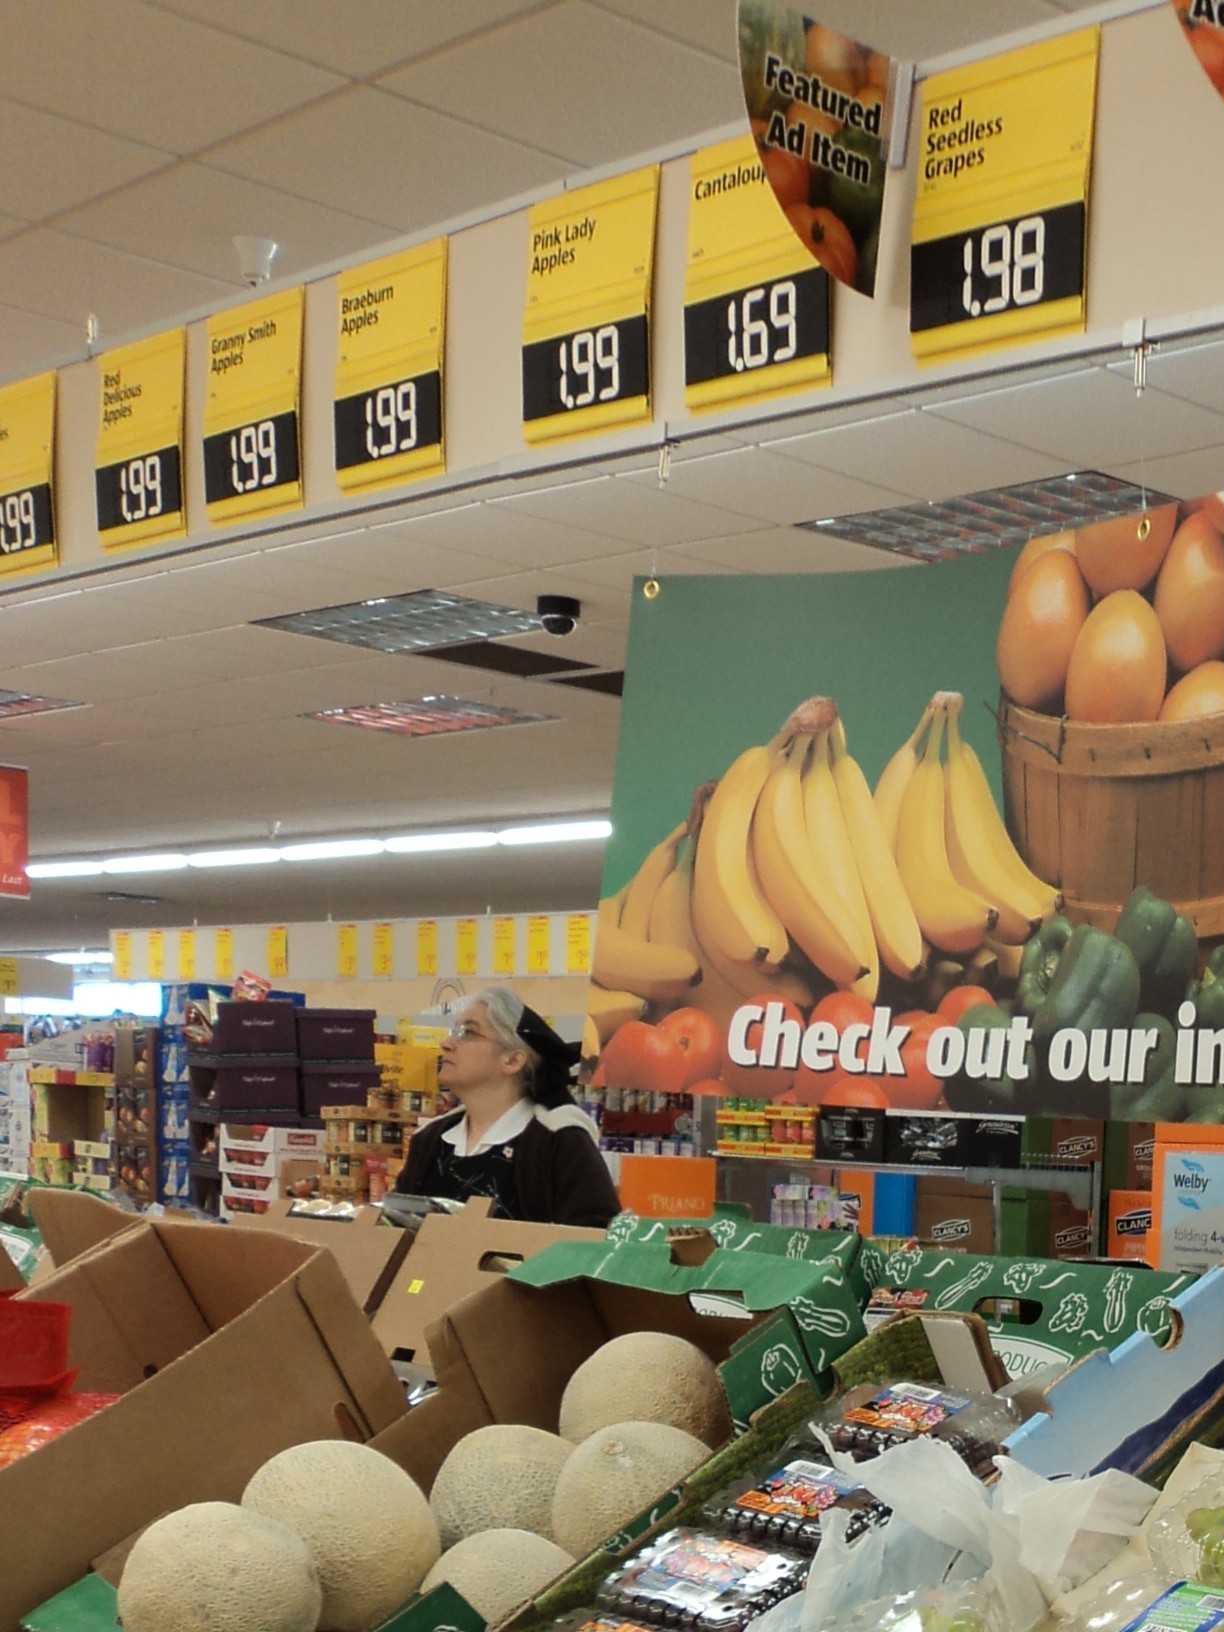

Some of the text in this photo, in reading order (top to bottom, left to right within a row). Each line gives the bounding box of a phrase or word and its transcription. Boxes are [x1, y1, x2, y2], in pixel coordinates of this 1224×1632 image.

[765, 56, 882, 135] Featured
[929, 99, 962, 129] Red
[767, 113, 871, 184] Ad Item
[926, 115, 1003, 155] Seedless
[924, 147, 985, 181] Grapes
[694, 163, 766, 201] Cantalou
[533, 216, 596, 252] Pink Lady
[532, 247, 576, 276] Apples
[963, 215, 1046, 317] 1.98
[341, 286, 394, 315] Braeburn
[211, 320, 276, 355] Granny Smith
[341, 309, 379, 338] Apples
[728, 280, 797, 372] 1.69
[103, 371, 121, 388] Red
[210, 352, 244, 375] Apples
[559, 324, 620, 409] 1.99
[103, 384, 142, 406] Delicious
[102, 404, 133, 425] Apples
[365, 381, 417, 459] 1.99
[230, 420, 277, 494] 1.99
[120, 455, 163, 523] 1.99
[727, 1001, 911, 1076] Check
[926, 1015, 1033, 1081] out
[1048, 1026, 1159, 1085] our
[1173, 1173, 1209, 1192] Welby
[1117, 1216, 1152, 1232] CLANC
[1174, 1228, 1208, 1245] folding
